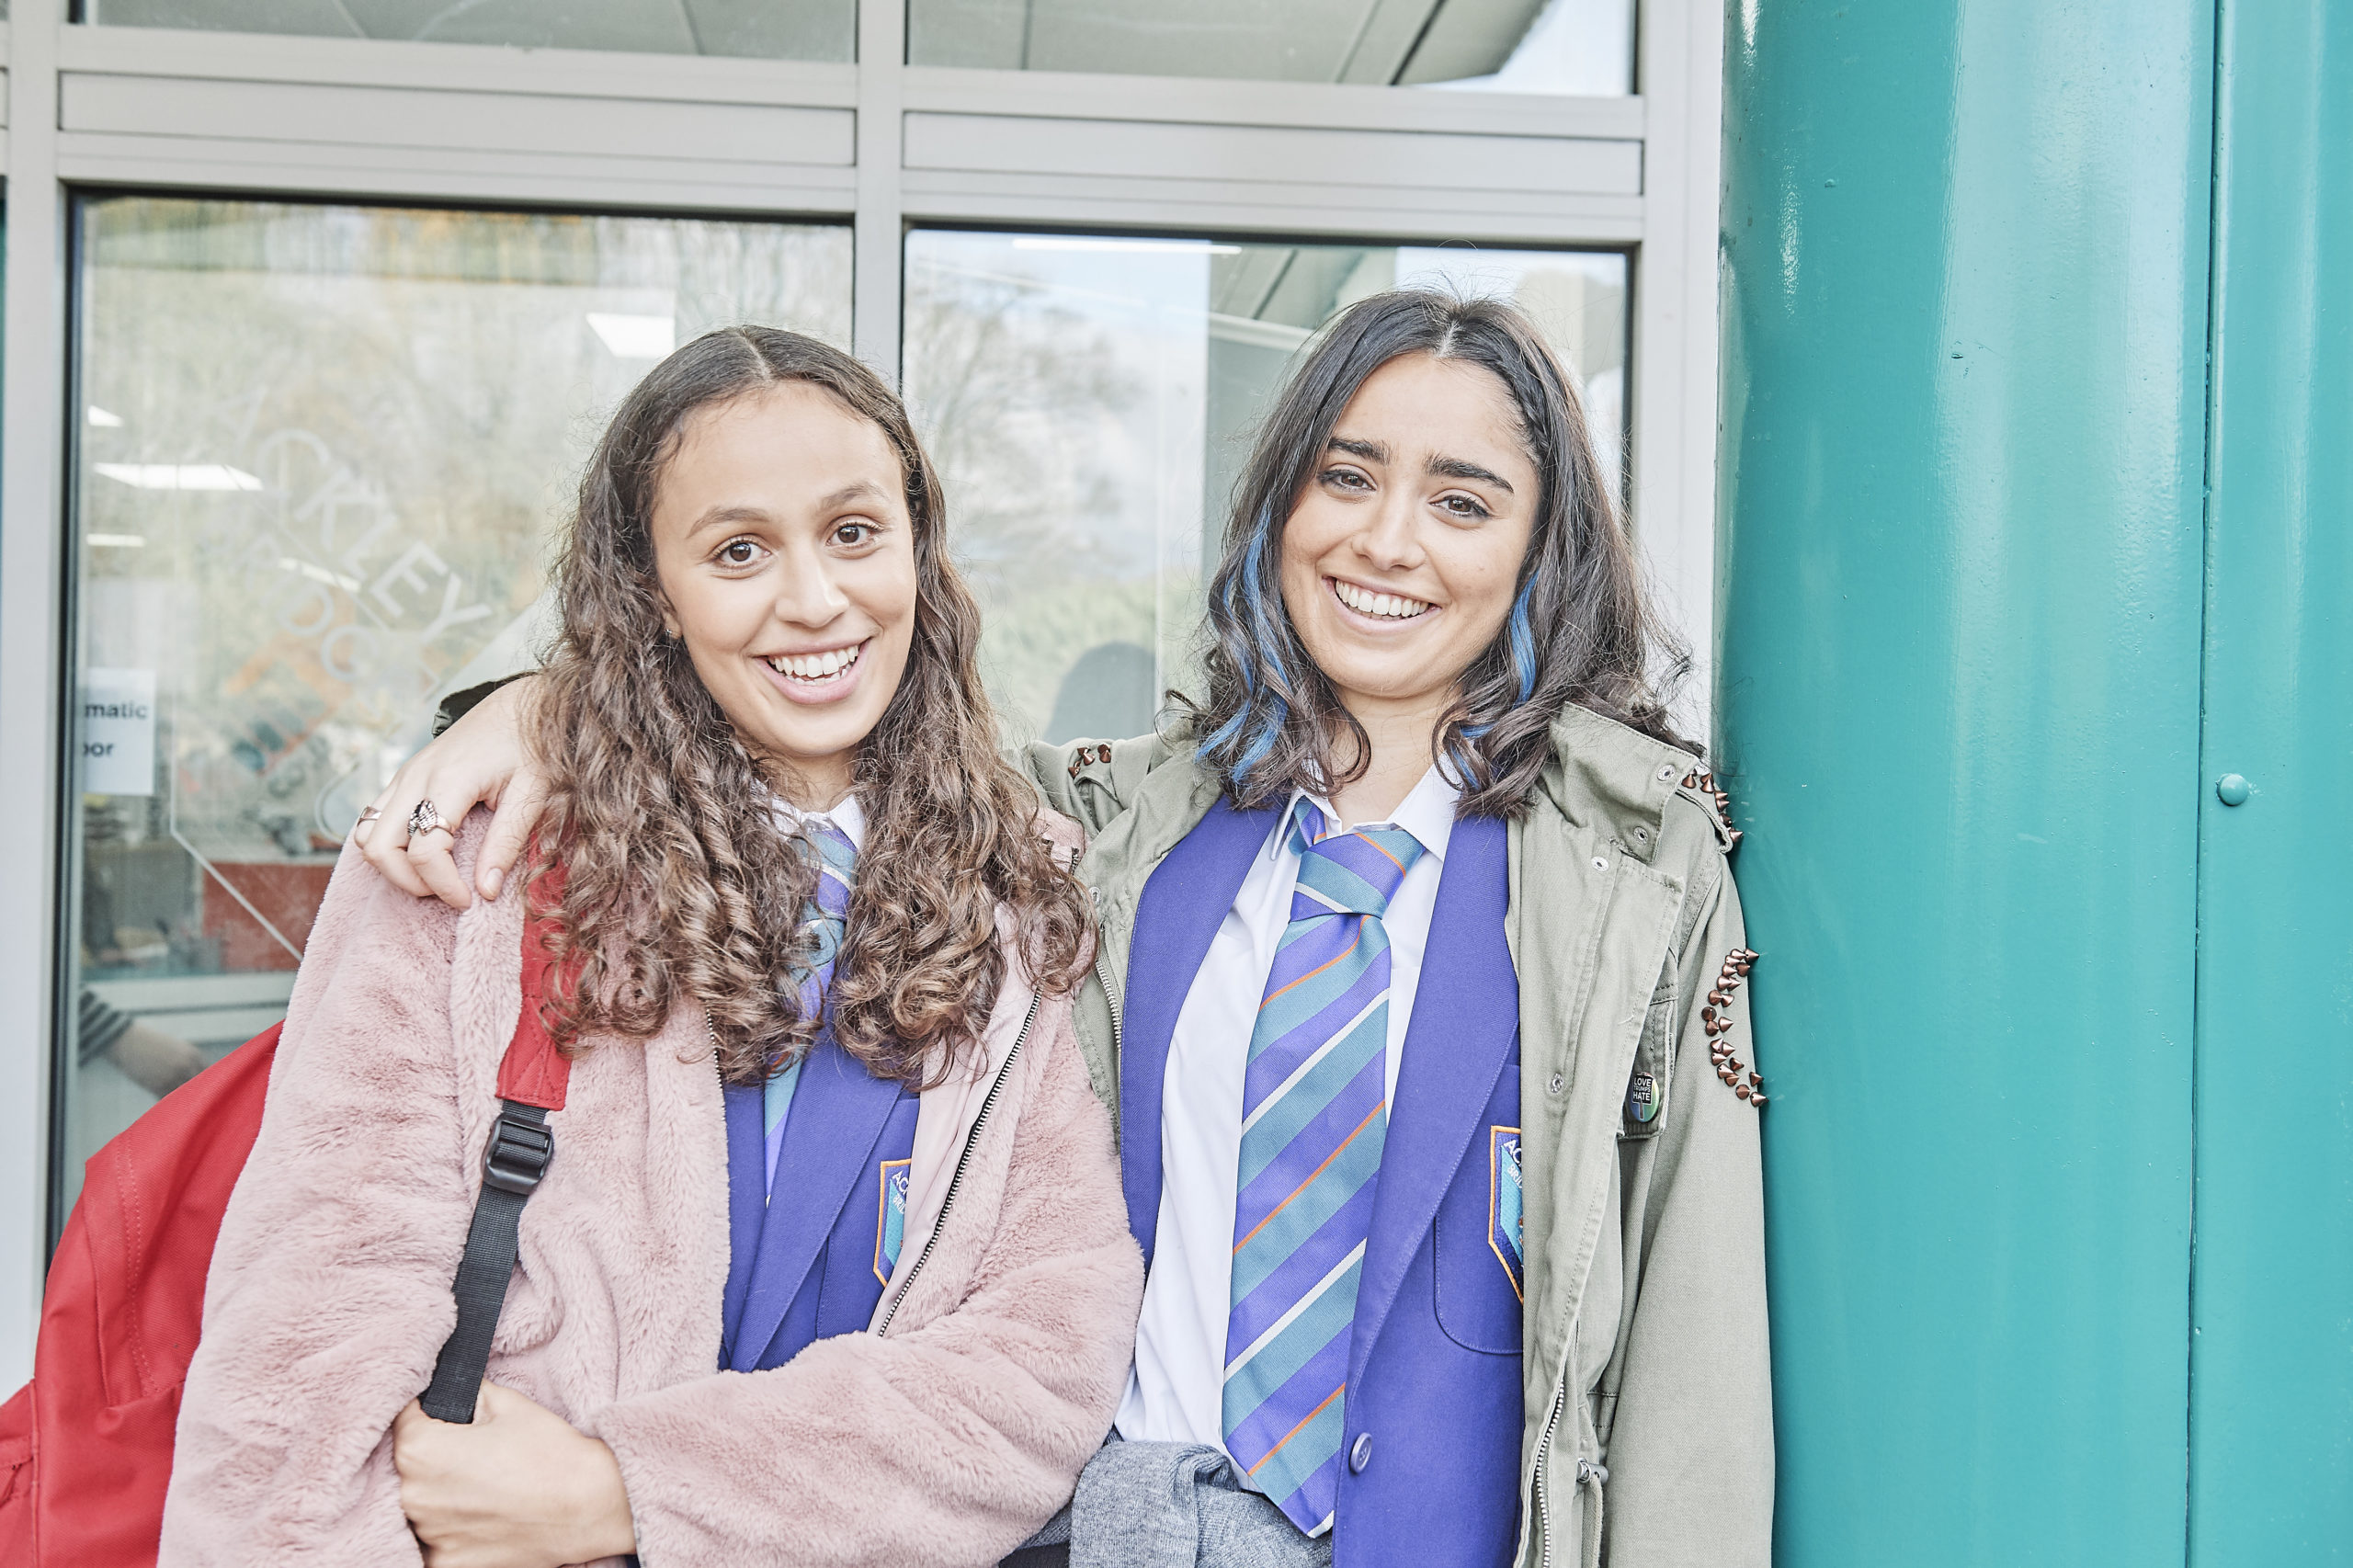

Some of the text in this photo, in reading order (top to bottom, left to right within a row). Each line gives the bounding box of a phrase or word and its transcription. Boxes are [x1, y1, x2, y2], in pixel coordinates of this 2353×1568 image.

[1633, 1077, 1652, 1087] LOVE
[1633, 1085, 1652, 1093] TRUMPS
[1632, 1091, 1651, 1101] HATE
[1504, 1140, 1522, 1167] AC
[892, 1170, 909, 1195] AC
